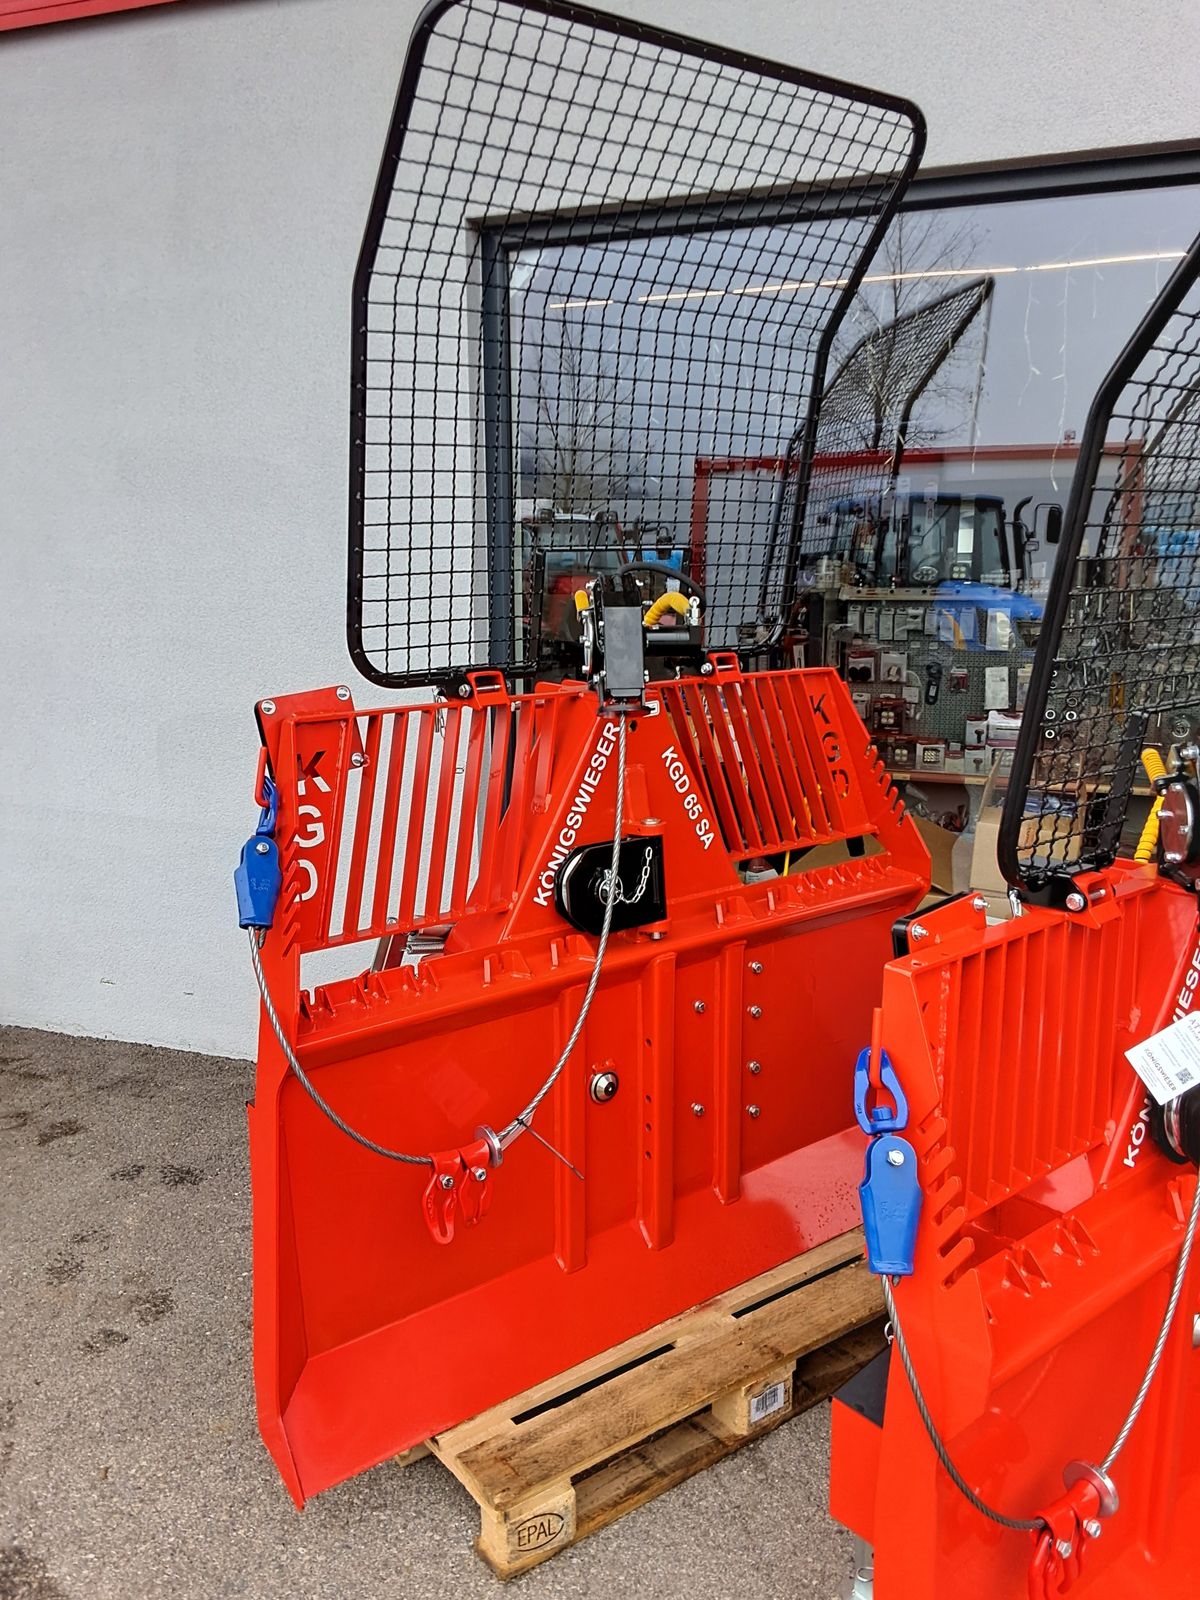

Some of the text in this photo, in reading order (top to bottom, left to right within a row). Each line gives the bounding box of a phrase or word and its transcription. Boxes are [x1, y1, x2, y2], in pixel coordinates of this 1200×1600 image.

[533, 721, 620, 907] KÖNIGSWIESER
[661, 745, 715, 850] KGD 65 SA
[517, 1518, 557, 1548] EPAL
